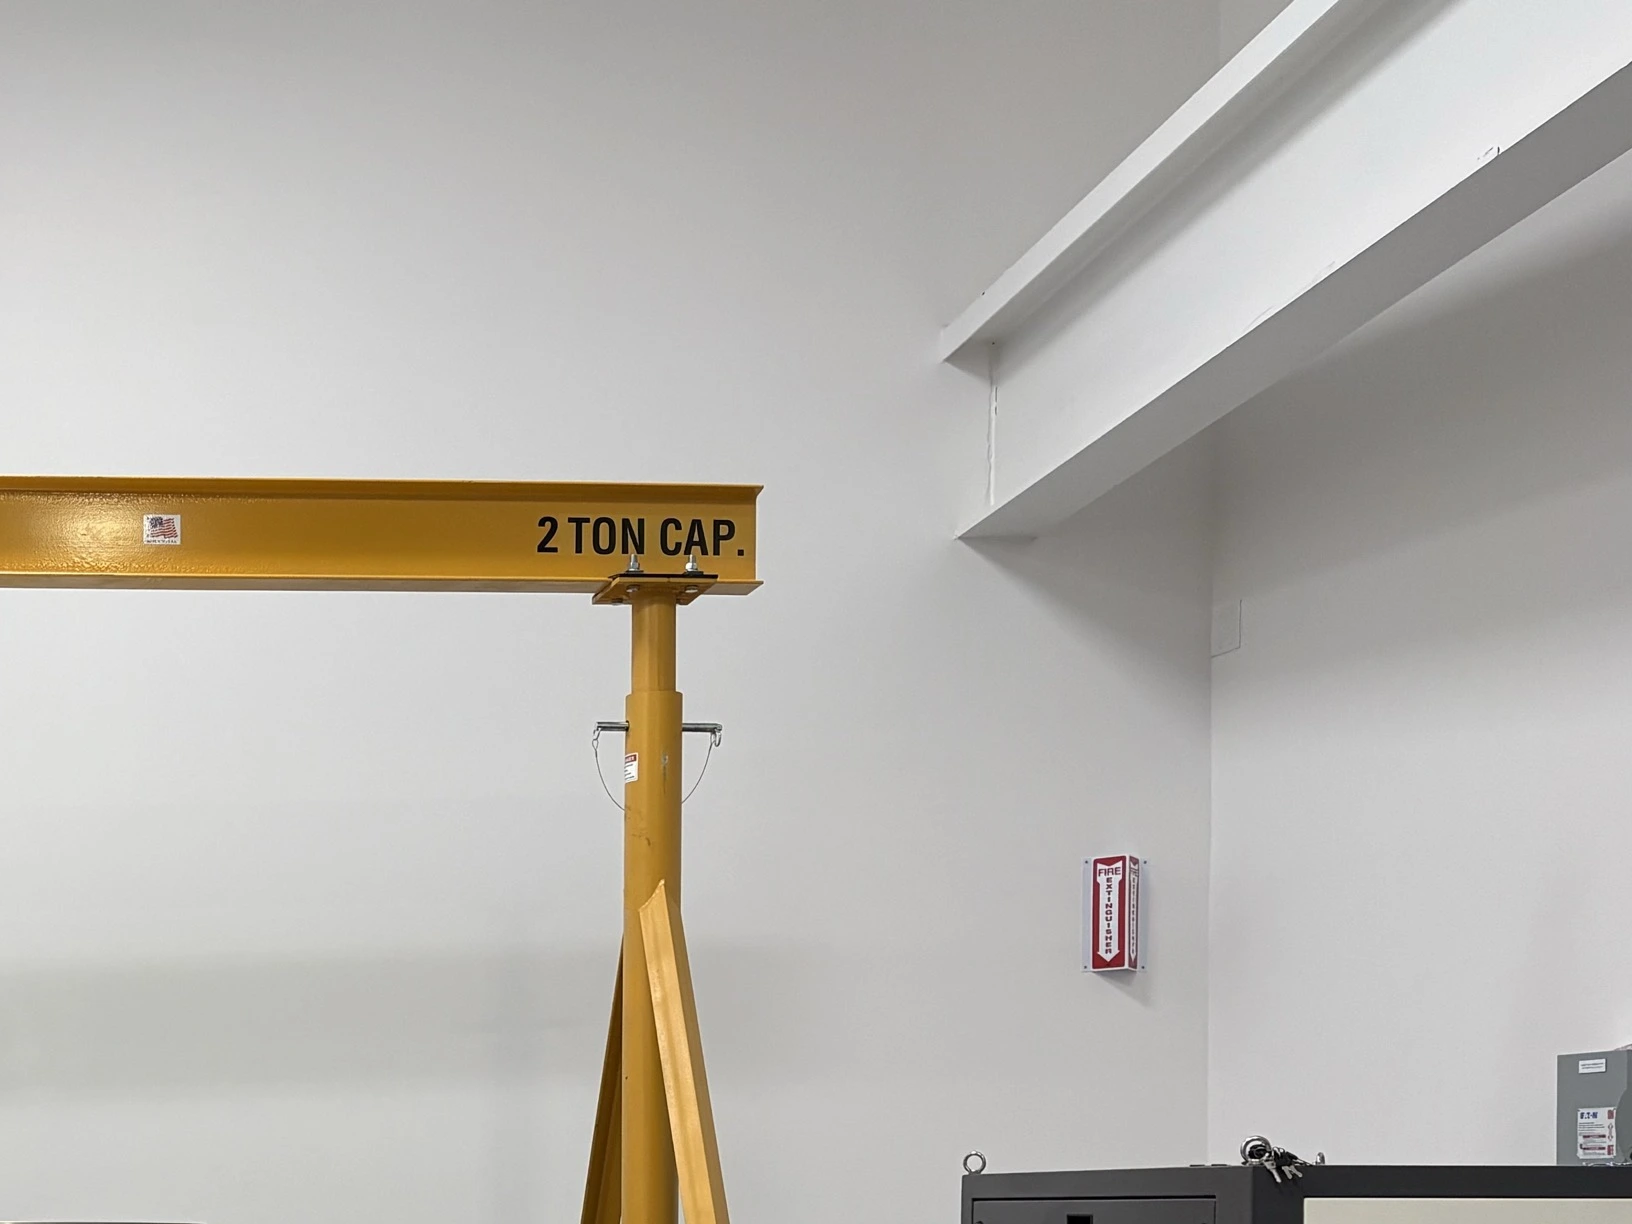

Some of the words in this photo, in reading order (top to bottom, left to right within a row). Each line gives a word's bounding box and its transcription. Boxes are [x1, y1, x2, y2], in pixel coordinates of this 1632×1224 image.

[537, 516, 558, 553] 2
[568, 517, 645, 555] TON
[660, 518, 745, 556] CAP.
[1098, 867, 1121, 877] FIRE
[1105, 877, 1113, 954] EXTINGUISHER
